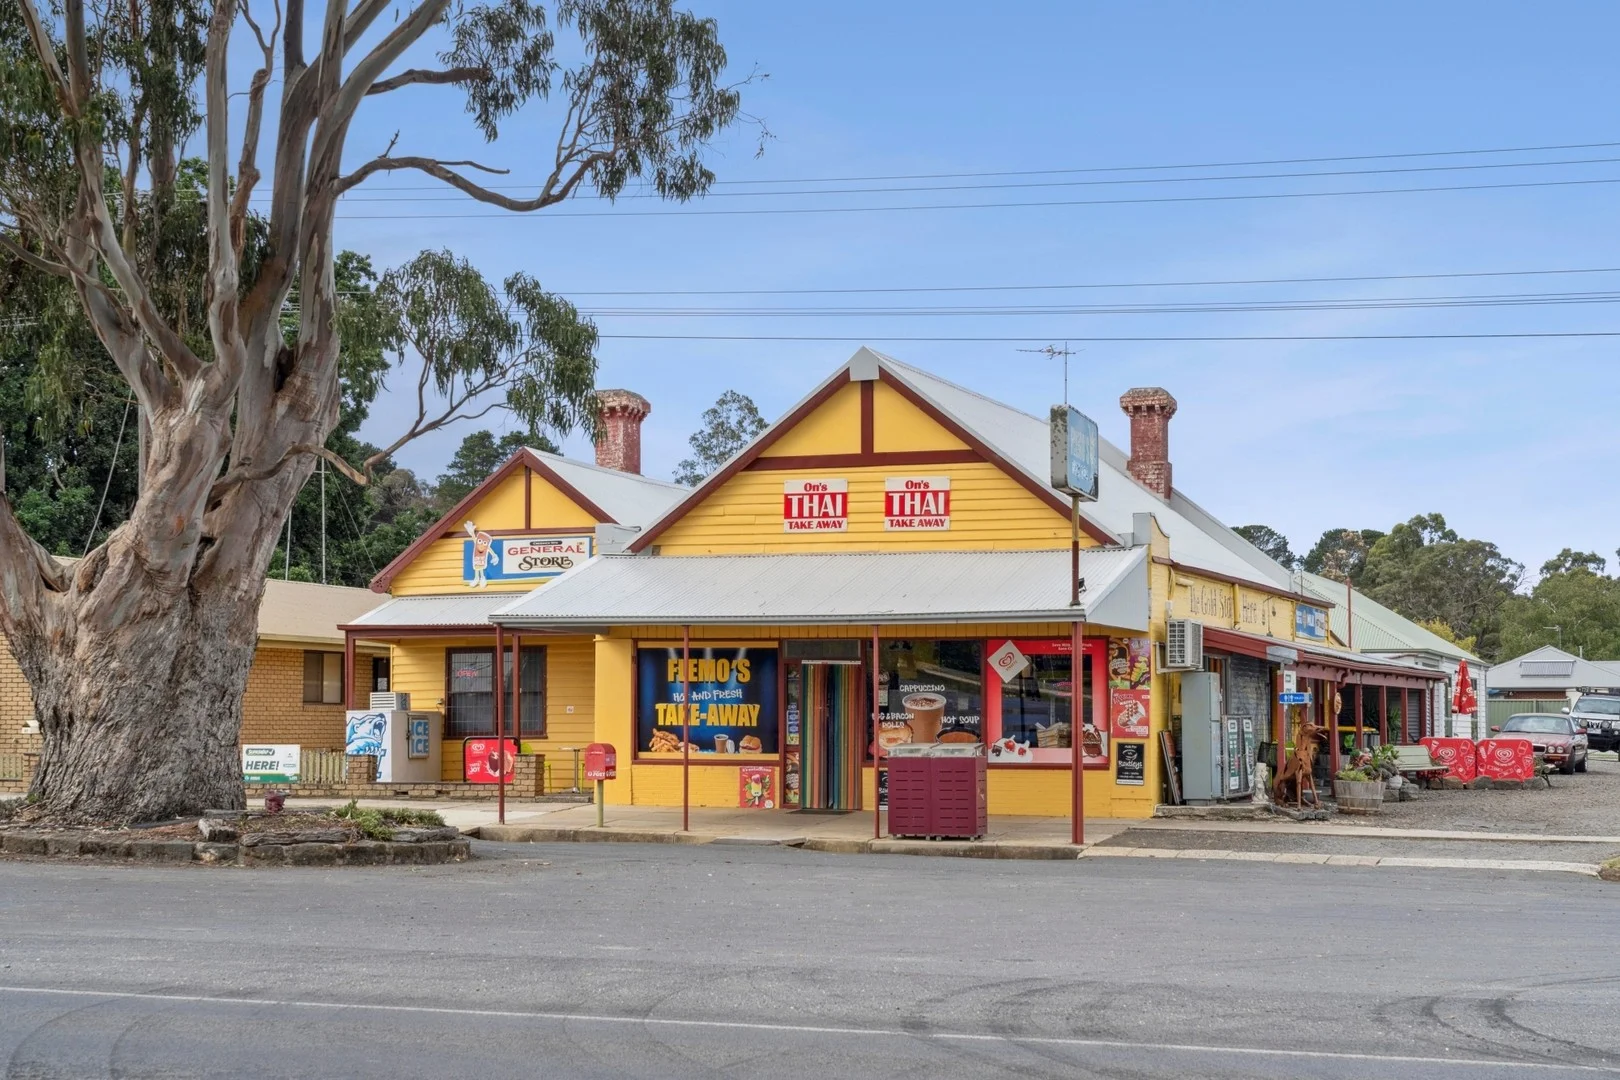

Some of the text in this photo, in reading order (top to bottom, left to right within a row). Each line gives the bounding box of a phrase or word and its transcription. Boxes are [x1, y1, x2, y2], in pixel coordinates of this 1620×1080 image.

[804, 482, 828, 492] On's
[905, 480, 929, 489] On's
[787, 493, 843, 518] THAI
[888, 492, 945, 516] THAI
[788, 520, 843, 529] TAKE AWAY
[889, 519, 946, 528] TAKE AWAY
[507, 544, 585, 556] GENERAL
[518, 556, 574, 571] STORE
[667, 658, 751, 683] FLEMO'S
[900, 684, 946, 692] CAPPUCCINO
[673, 689, 742, 702] HO AND FRESH
[655, 703, 760, 727] TAKE-AWAY
[891, 712, 914, 720] BACON
[941, 715, 980, 724] HOT SOUP
[411, 720, 429, 736] ICE
[411, 738, 429, 753] ICE
[245, 760, 279, 771] HERE!
